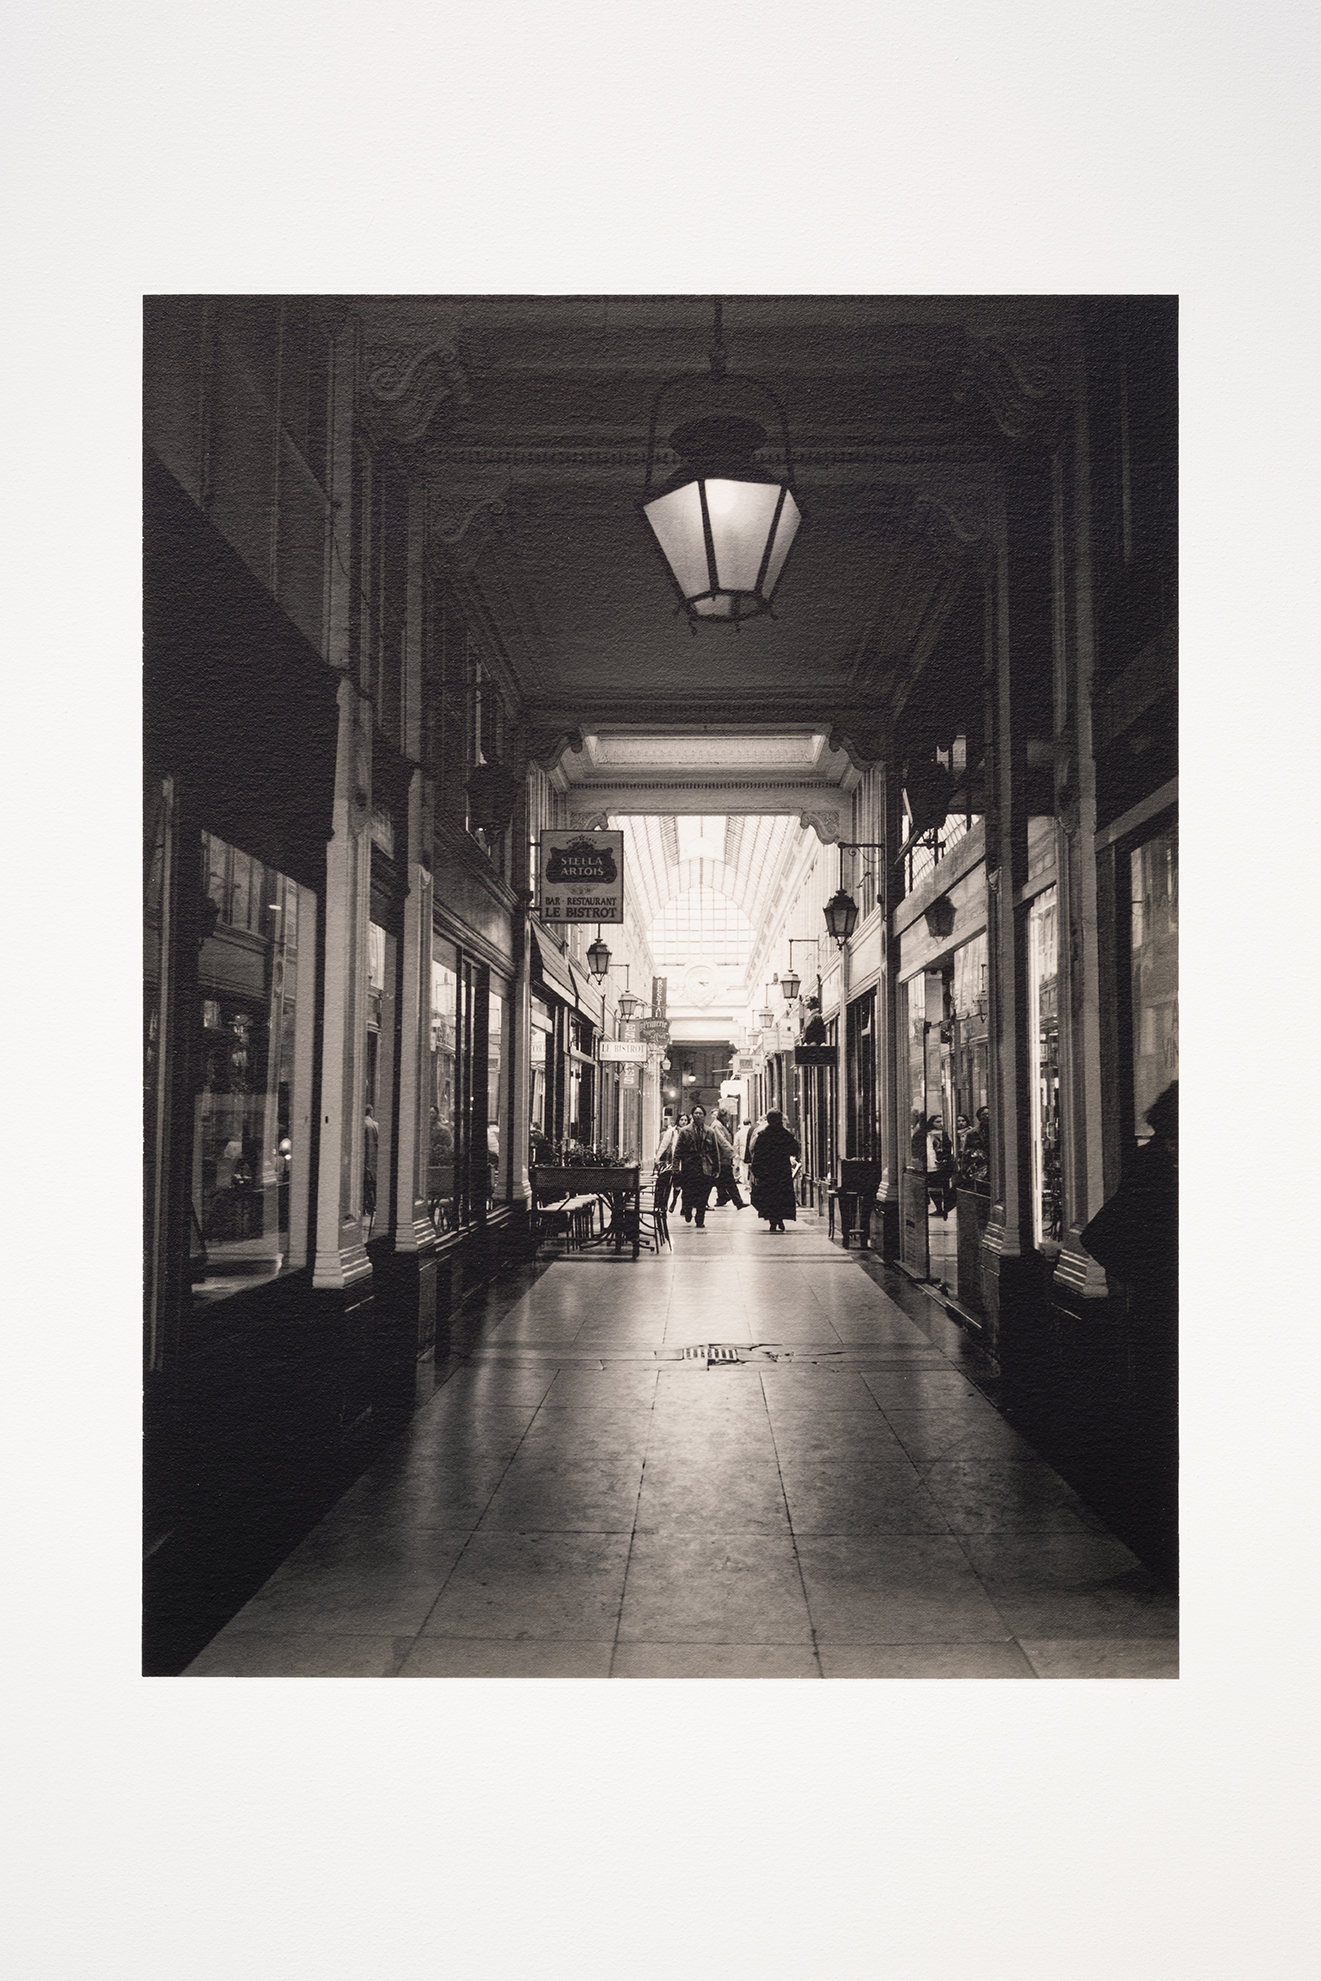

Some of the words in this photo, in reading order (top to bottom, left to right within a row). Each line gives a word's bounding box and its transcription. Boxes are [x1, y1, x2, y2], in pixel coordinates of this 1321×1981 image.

[561, 857, 603, 865] STELLA
[561, 867, 604, 876] ARTOIS
[545, 897, 560, 905] BAR
[567, 897, 617, 905] RESTAURANT
[545, 907, 560, 918] LE
[566, 907, 617, 918] BISTROT
[614, 1044, 646, 1054] BISTROT
